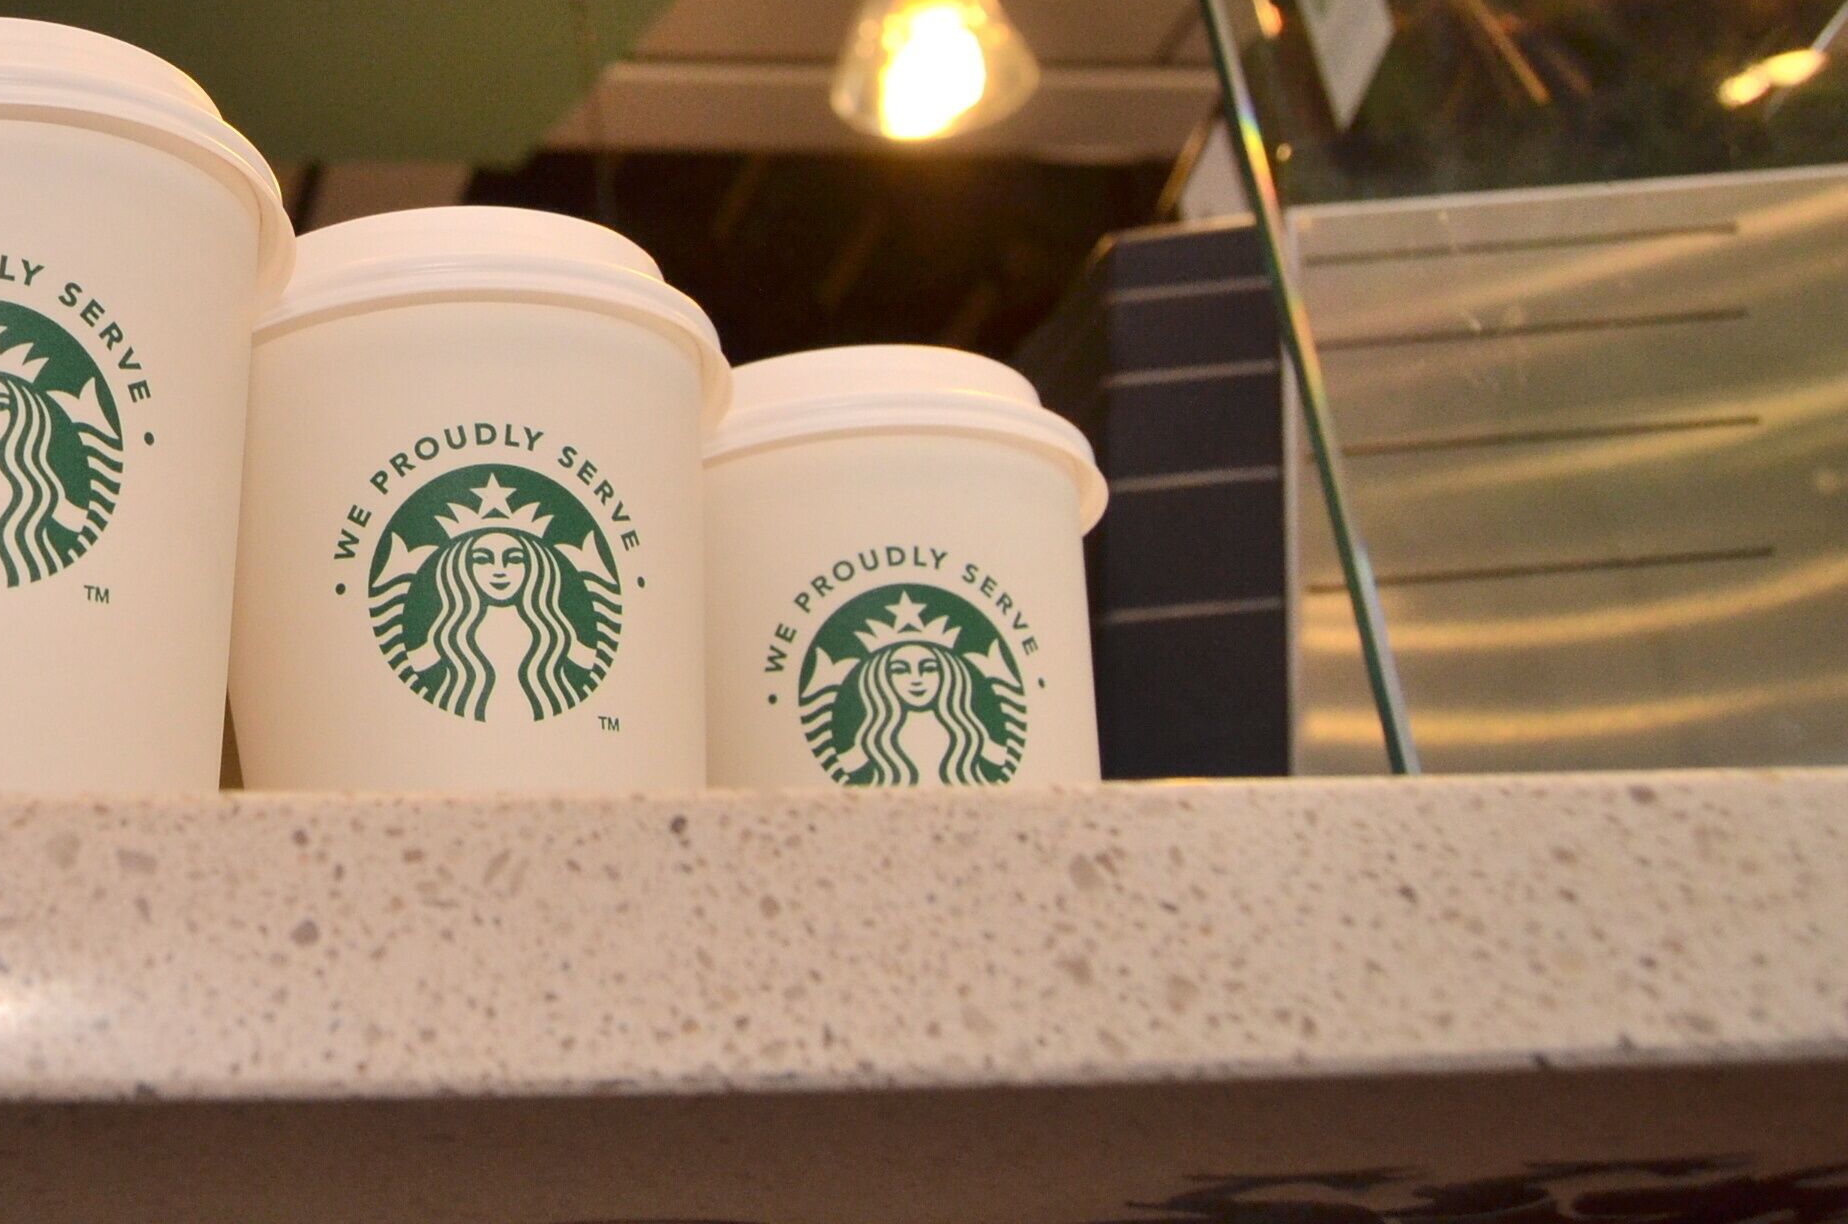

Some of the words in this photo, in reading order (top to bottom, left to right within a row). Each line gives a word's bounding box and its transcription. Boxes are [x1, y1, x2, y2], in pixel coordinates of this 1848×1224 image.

[56, 281, 152, 403] SERVE
[333, 504, 371, 563] WE
[369, 421, 544, 494] PROUDLY
[558, 444, 641, 552] SERVE
[83, 585, 110, 604] TM
[764, 623, 798, 675] WE
[792, 544, 948, 614] PROUDLY
[962, 563, 1039, 657] SERVE
[597, 715, 621, 732] TM
